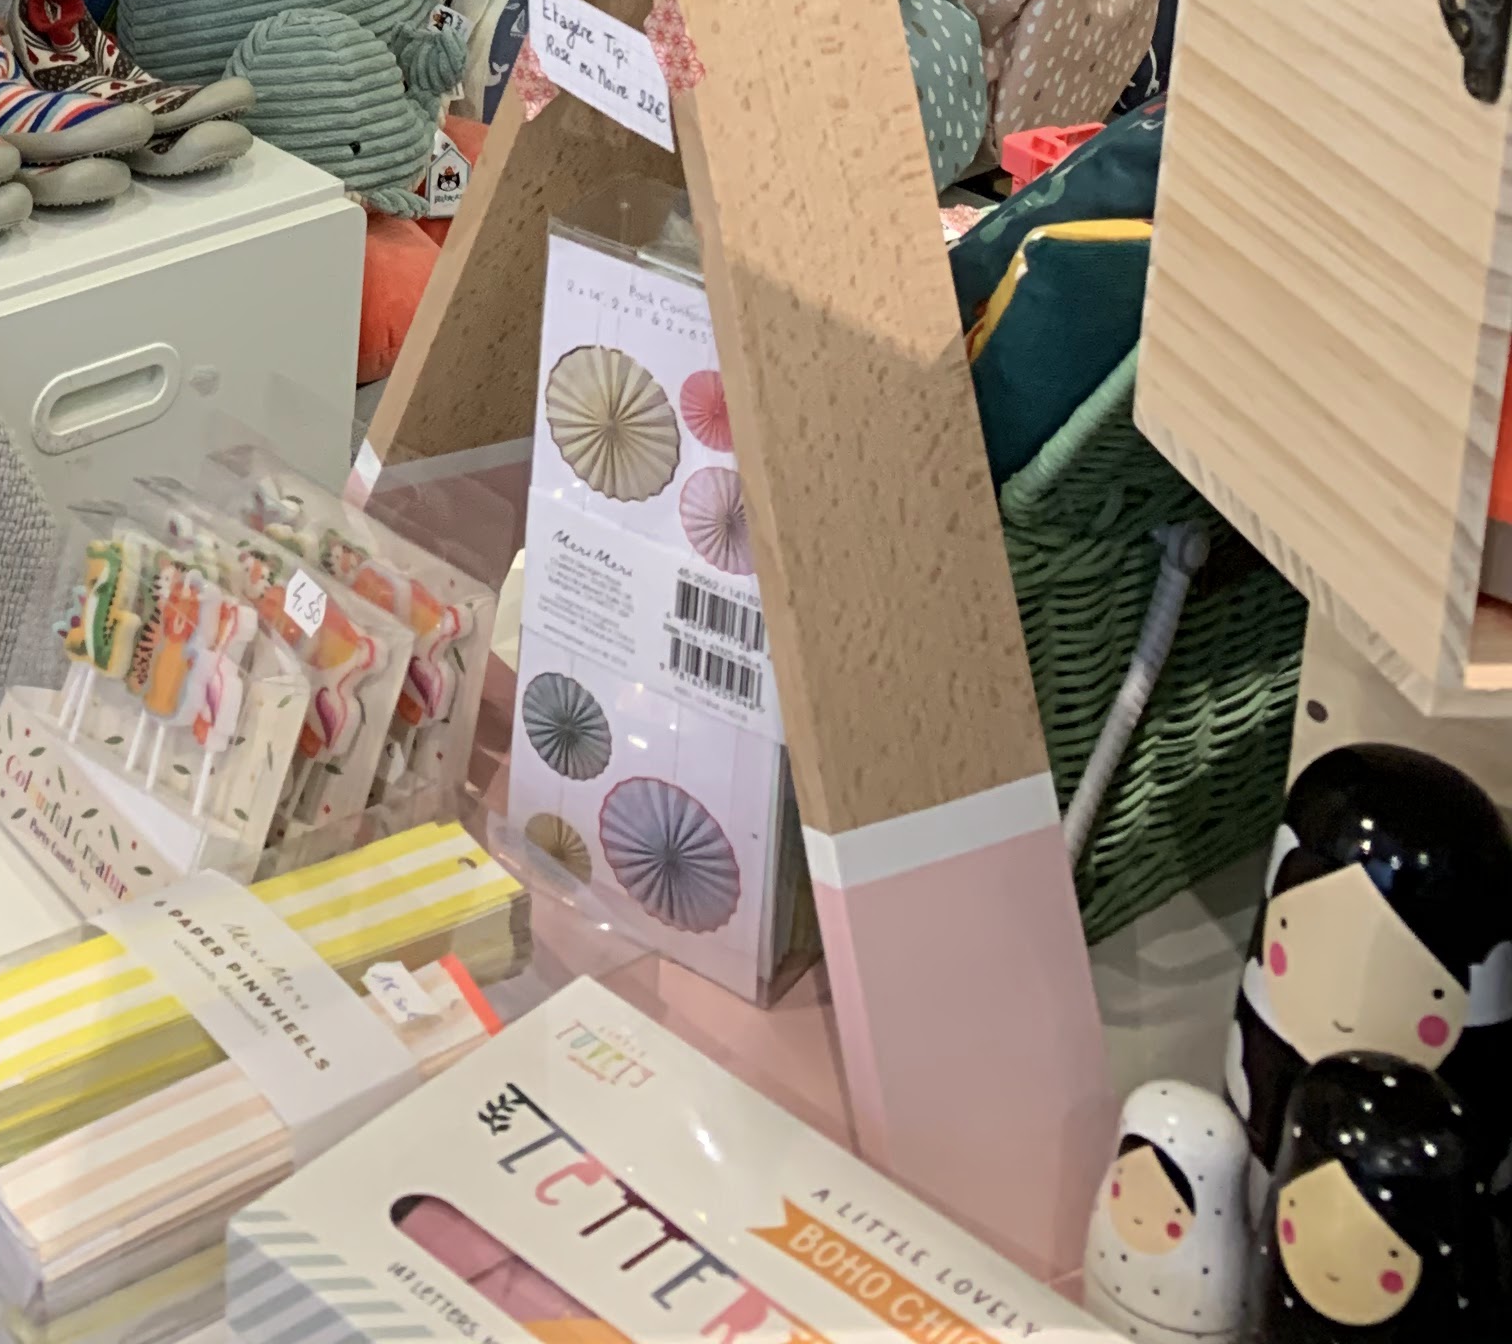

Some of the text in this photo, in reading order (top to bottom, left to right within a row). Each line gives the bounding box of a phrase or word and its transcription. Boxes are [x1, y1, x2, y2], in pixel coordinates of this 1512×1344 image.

[546, 34, 571, 66] Rose
[637, 89, 667, 124] 22€
[553, 529, 633, 577] Meri Meri
[168, 908, 330, 1071] PAPER PINWHEELS
[789, 1222, 892, 1301] BOHO
[810, 1189, 1041, 1339] A LITTLE LOVELY
